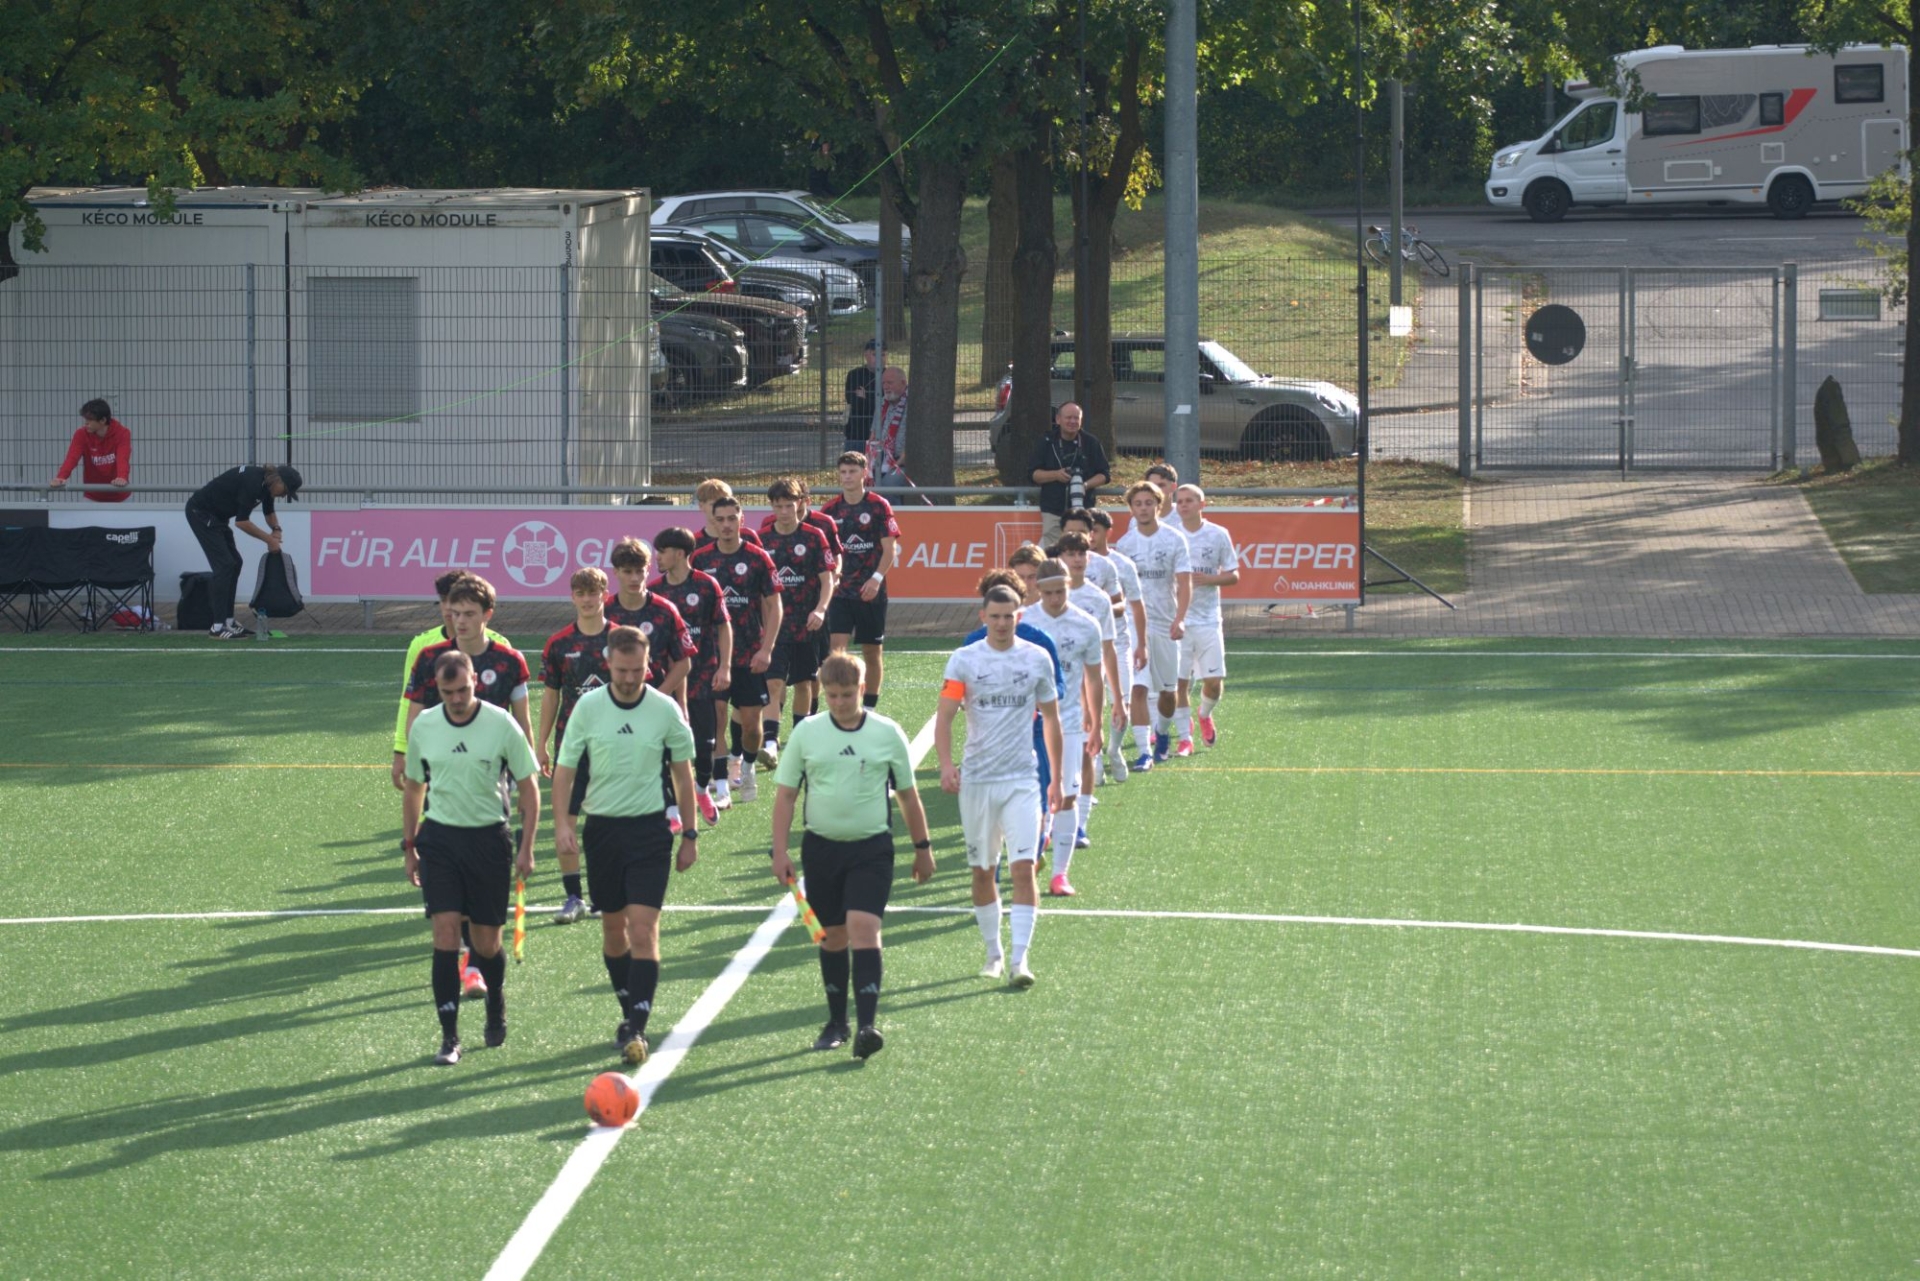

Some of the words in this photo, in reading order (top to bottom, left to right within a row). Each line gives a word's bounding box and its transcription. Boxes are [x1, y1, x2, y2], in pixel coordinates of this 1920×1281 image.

[82, 209, 129, 225] KÉCO
[366, 210, 416, 227] KÉCO
[421, 214, 497, 227] MODULE
[317, 530, 394, 568] FÜR
[399, 538, 495, 568] ALLE
[907, 543, 988, 568] ALLE
[1291, 581, 1356, 591] NOAHKLINIK
